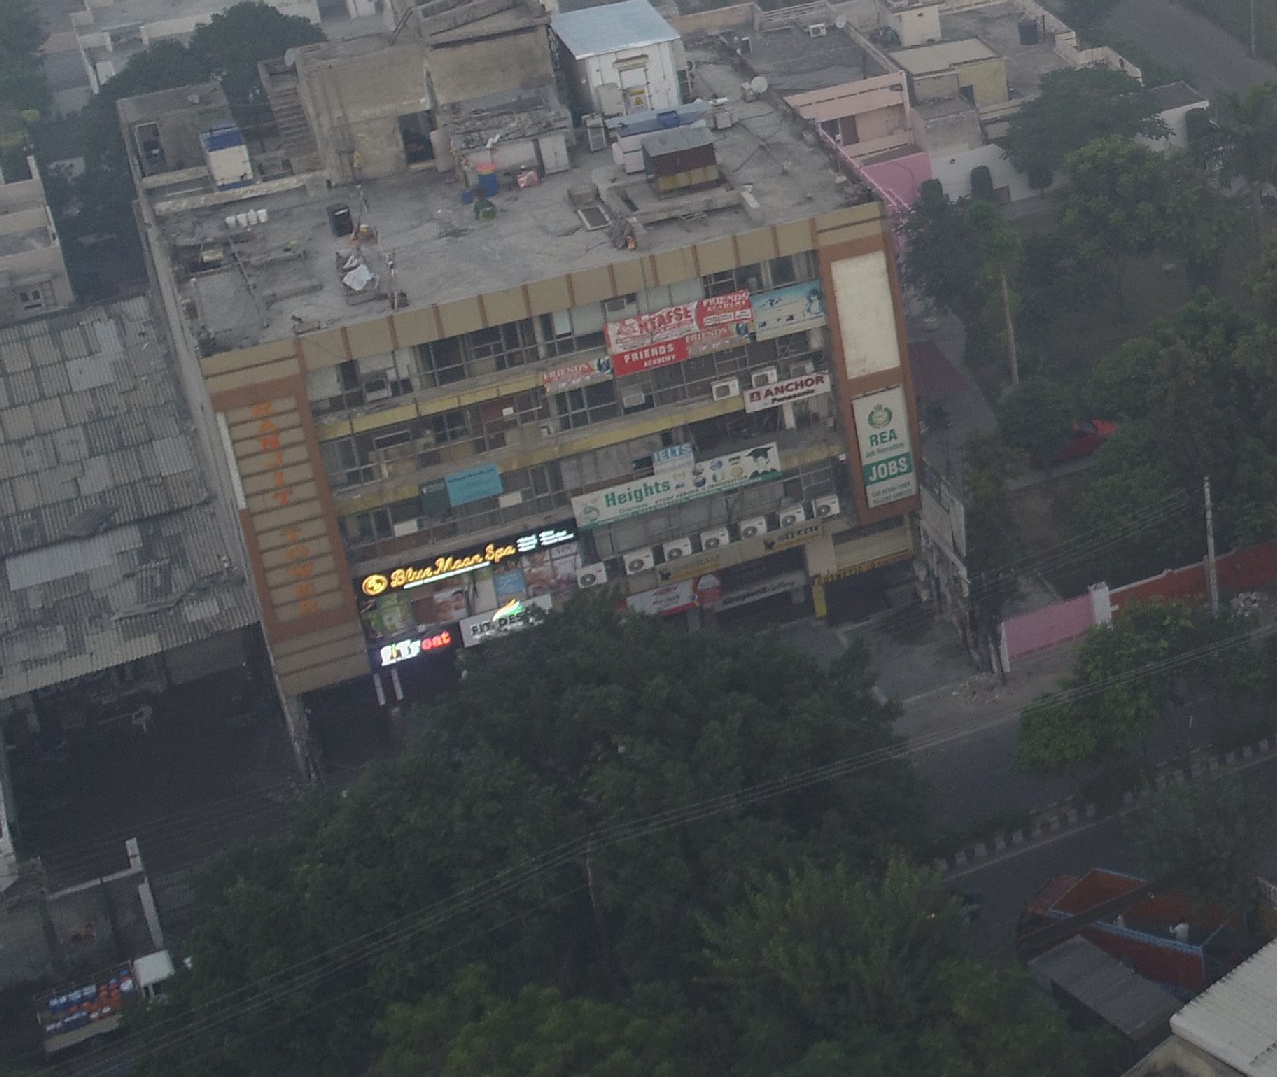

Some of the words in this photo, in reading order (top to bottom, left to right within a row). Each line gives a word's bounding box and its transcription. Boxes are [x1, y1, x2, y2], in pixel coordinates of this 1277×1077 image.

[623, 344, 675, 364] FRIENDS
[763, 375, 825, 398] ANCHOR
[868, 428, 898, 447] REA
[652, 442, 693, 463] IELTS
[868, 457, 908, 482] JOBS
[603, 478, 671, 508] Heights
[390, 568, 433, 589] Blue
[431, 553, 484, 576] Moon
[485, 543, 517, 563] Spa
